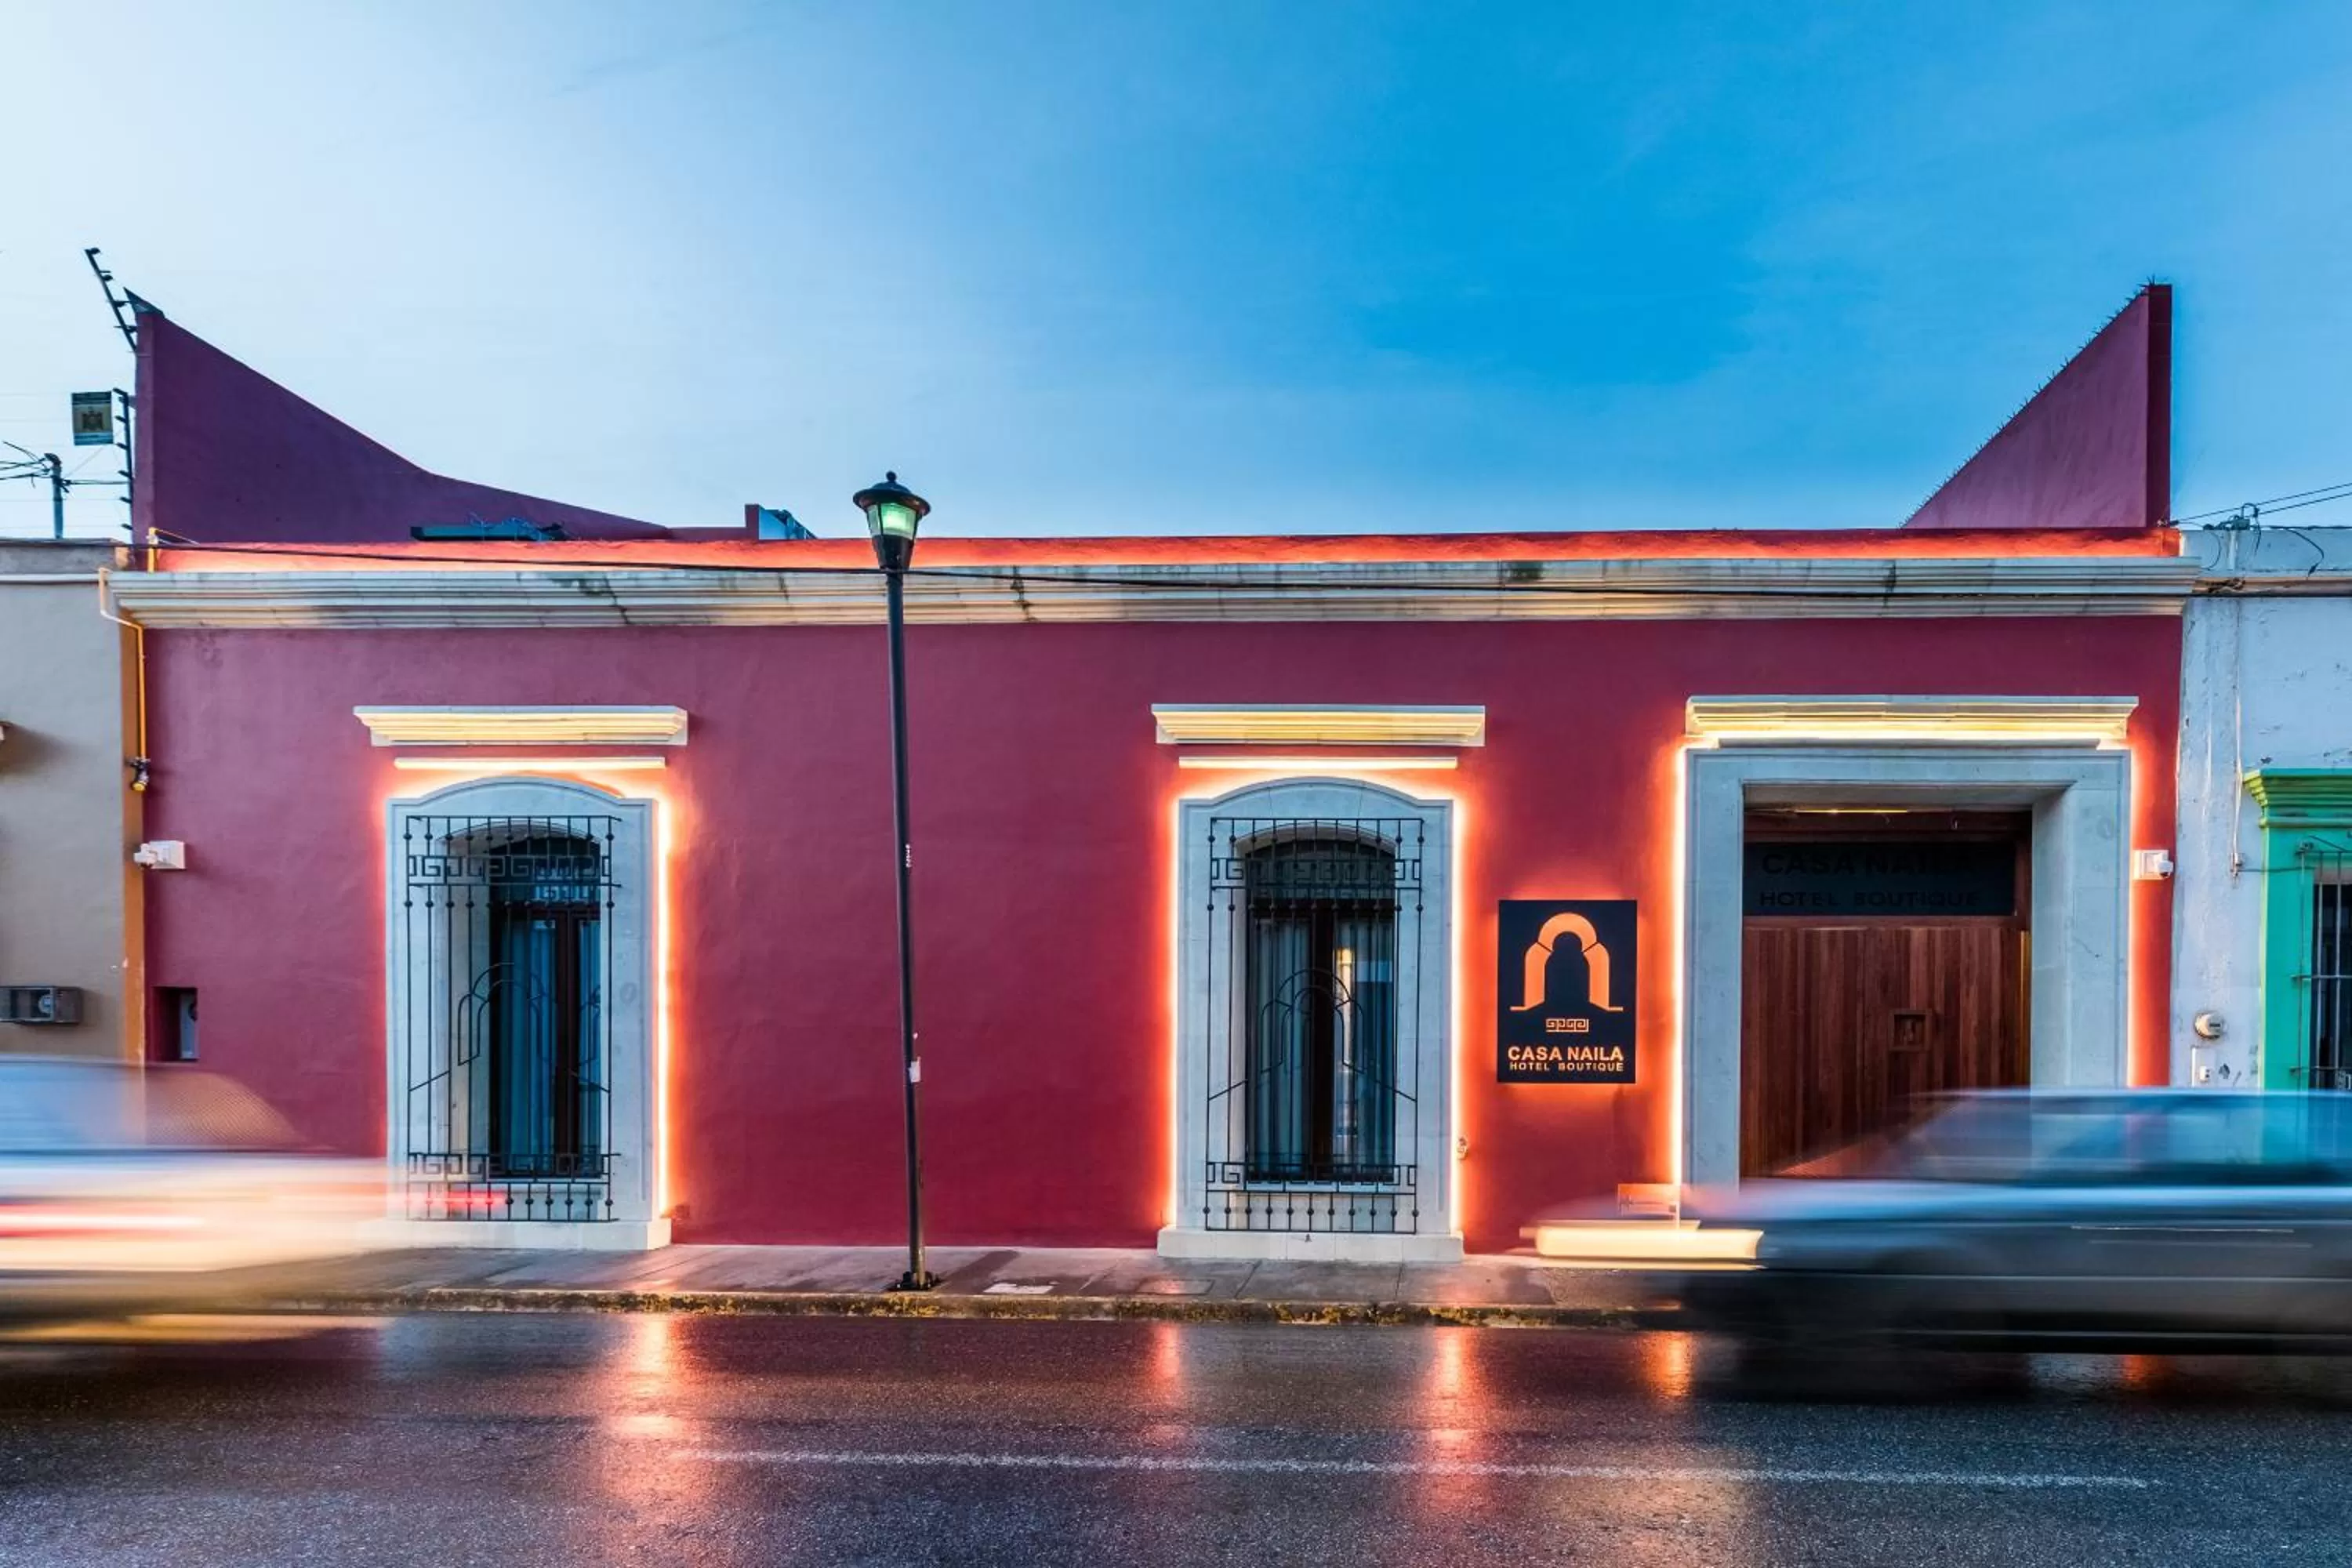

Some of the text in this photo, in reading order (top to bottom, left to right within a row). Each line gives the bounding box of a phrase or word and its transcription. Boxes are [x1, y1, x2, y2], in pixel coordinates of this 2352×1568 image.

[1508, 1046, 1624, 1061] CASA NAILA
[1509, 1062, 1624, 1072] HOTEL BOUTIQUE
